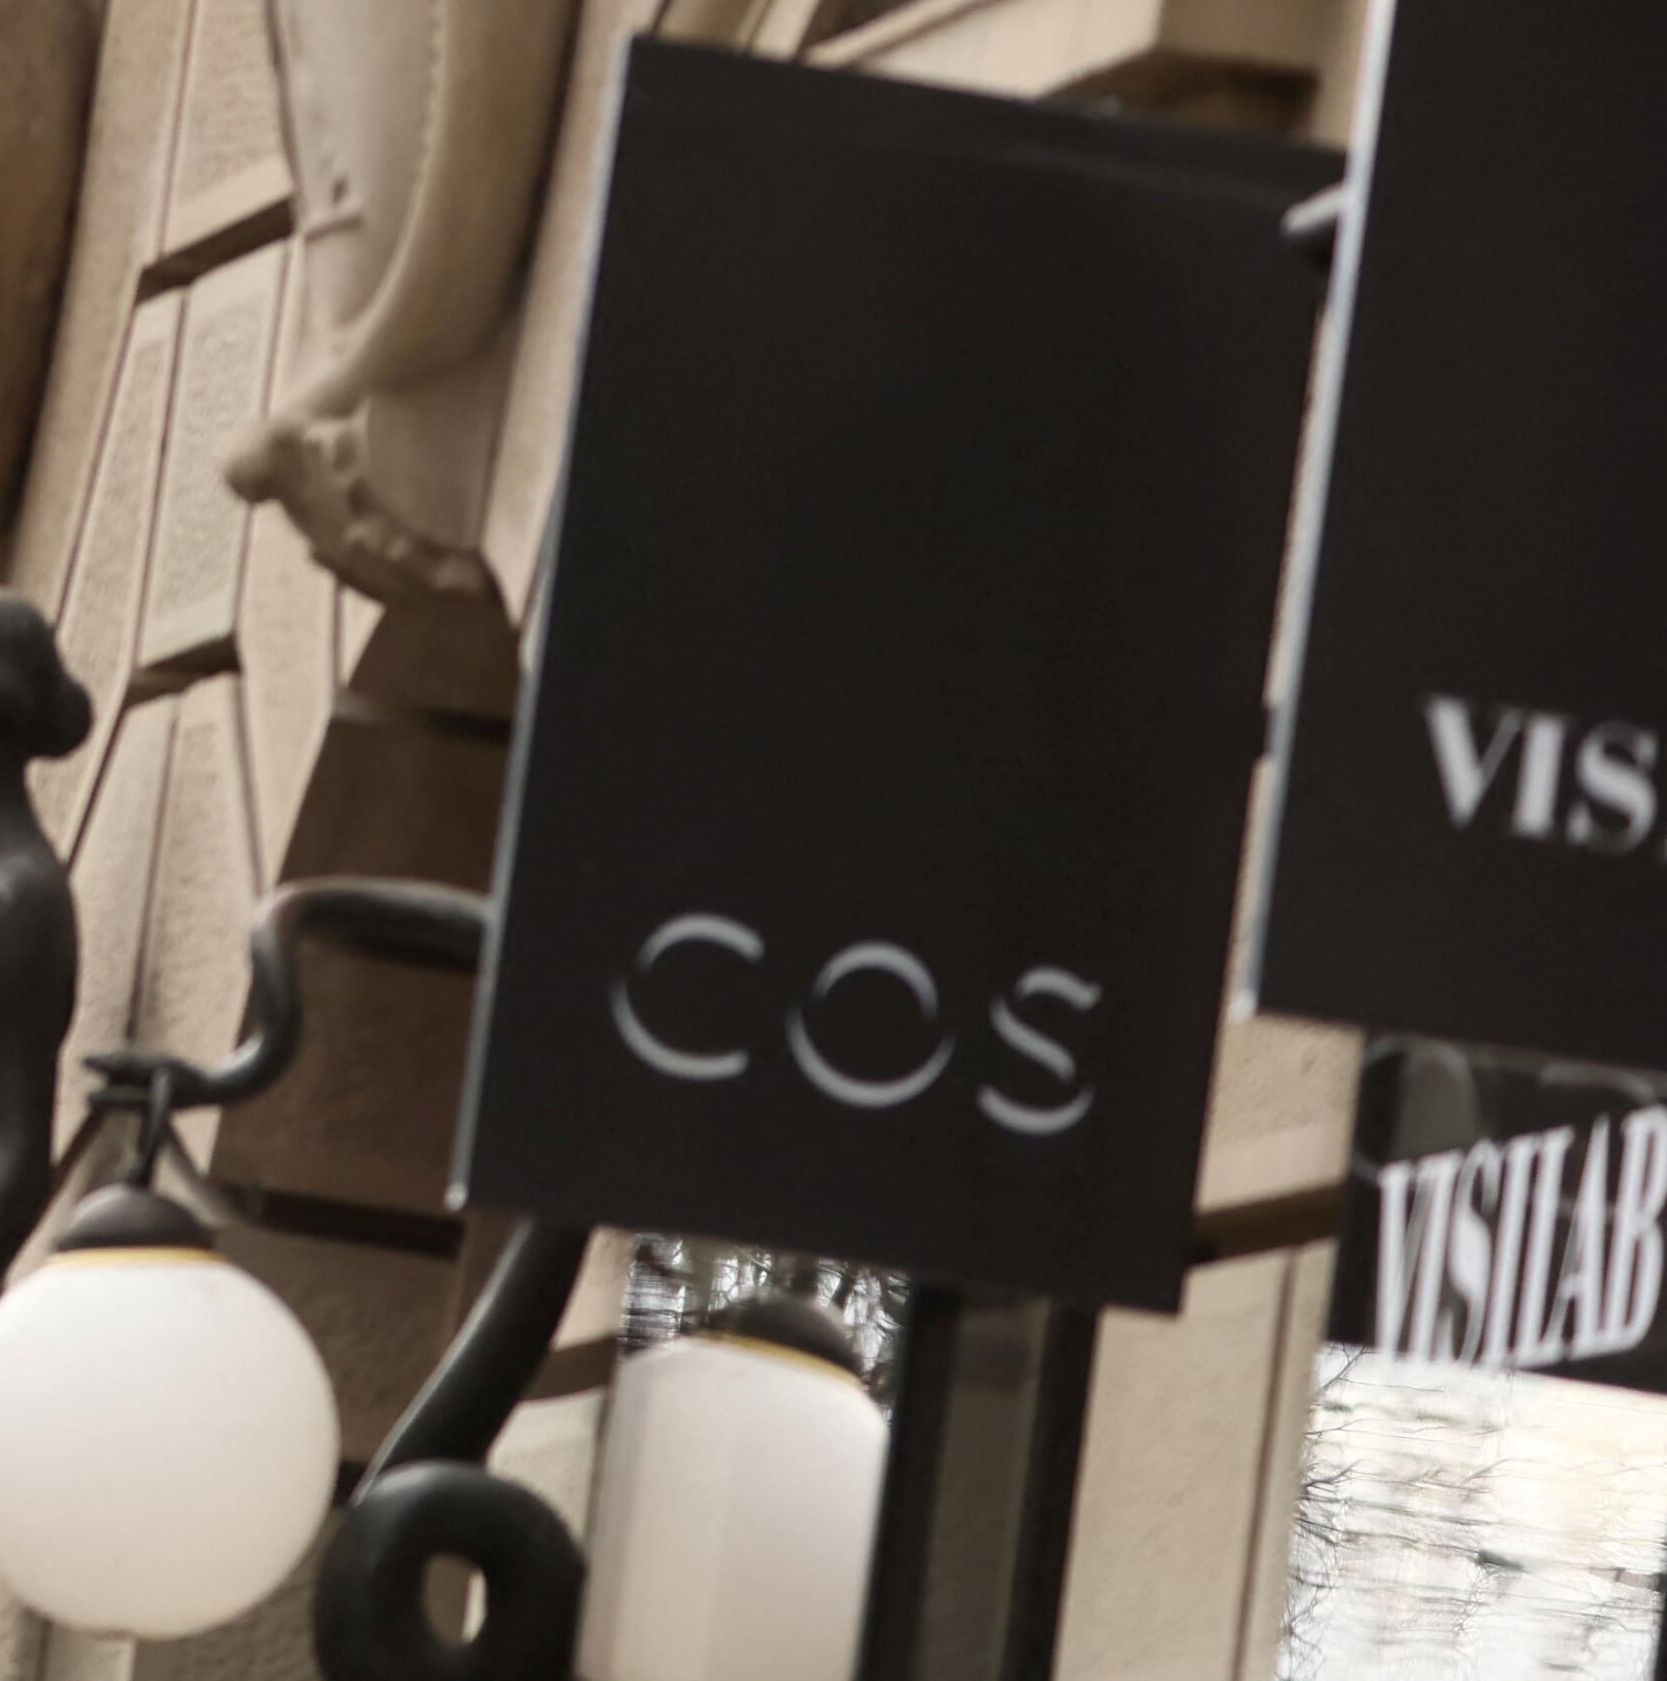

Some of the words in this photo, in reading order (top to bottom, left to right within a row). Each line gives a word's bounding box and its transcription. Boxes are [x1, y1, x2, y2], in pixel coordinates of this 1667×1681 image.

[1423, 691, 1667, 865] VIS
[609, 913, 1103, 1136] COS
[1374, 1105, 1667, 1369] VISILAB
